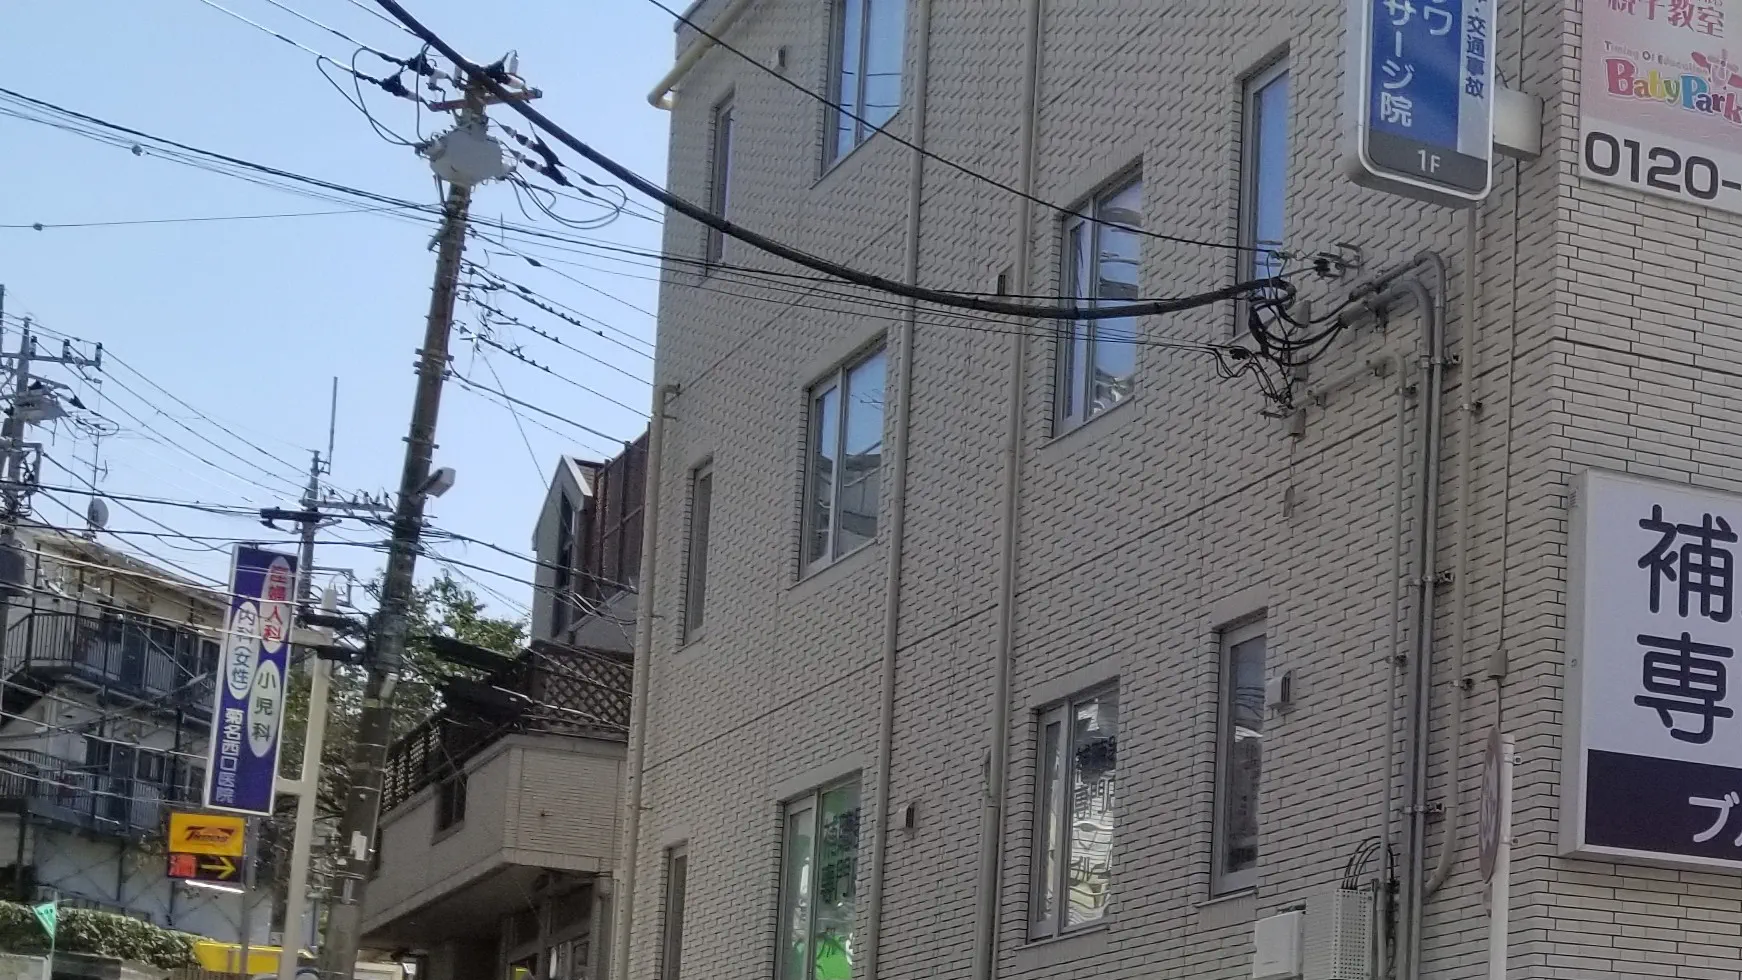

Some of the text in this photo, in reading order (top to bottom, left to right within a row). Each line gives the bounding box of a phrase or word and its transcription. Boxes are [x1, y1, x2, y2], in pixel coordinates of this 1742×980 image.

[1417, 149, 1441, 173] 1F
[251, 671, 277, 742] 小児科
